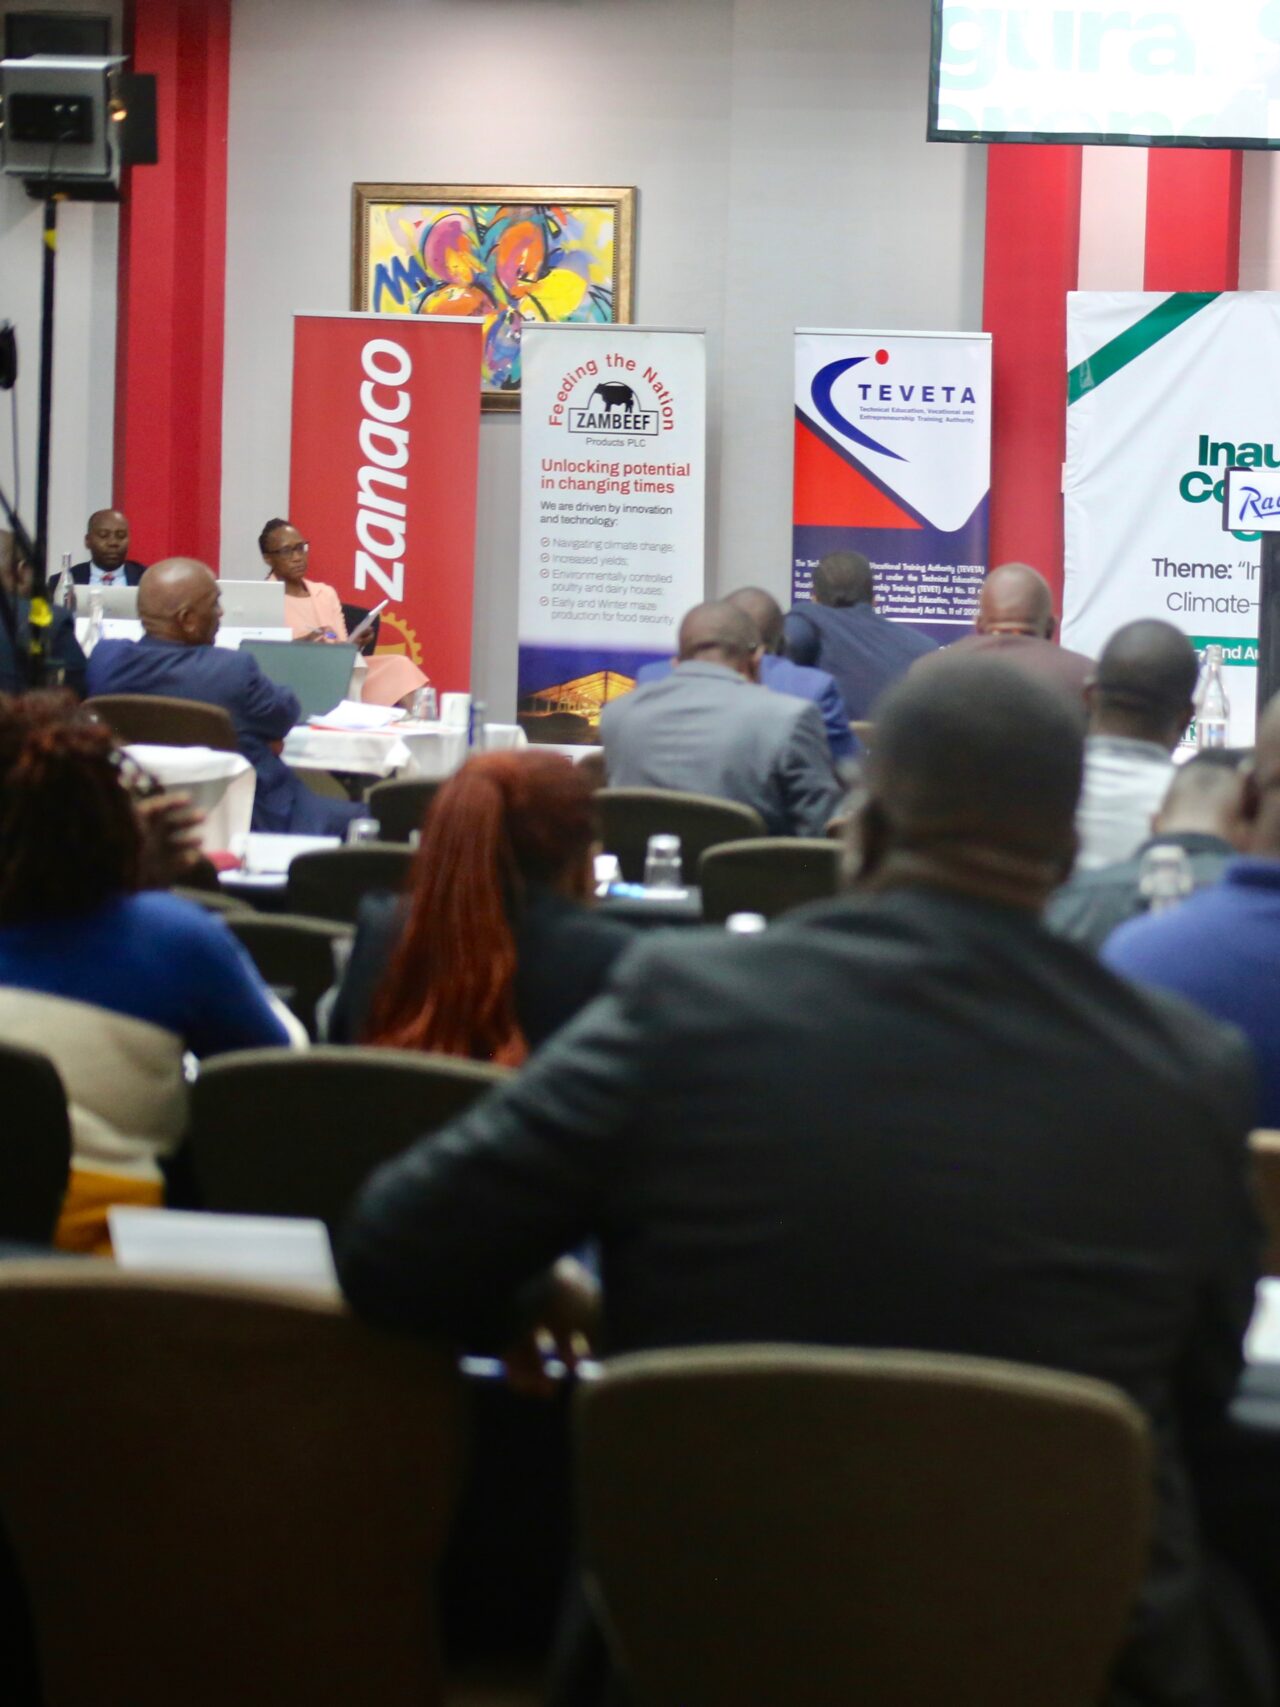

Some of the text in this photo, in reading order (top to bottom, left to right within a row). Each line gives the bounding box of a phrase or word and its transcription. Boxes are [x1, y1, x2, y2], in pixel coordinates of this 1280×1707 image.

[548, 353, 675, 430] Feeding the Nation
[858, 384, 976, 404] TEVETA
[576, 412, 651, 430] ZAMBEEF
[860, 414, 974, 424] Entrepreneurship Training Authority
[586, 437, 646, 448] Products PLC
[354, 338, 413, 601] zanaco
[541, 459, 691, 477] Unlocking potential
[541, 475, 675, 495] in changing times
[540, 501, 673, 515] We are driven by innovation
[540, 514, 559, 524] and
[553, 538, 603, 550] Navigating
[604, 539, 638, 550] climate
[553, 554, 598, 565] Increased
[1152, 558, 1233, 580] Theme:
[552, 569, 673, 584] Environmentally controlled
[552, 582, 582, 594] poultry
[585, 583, 603, 593] and
[605, 583, 628, 595] dairy
[552, 597, 657, 611] Early and Winter maize
[1166, 592, 1261, 614] Climate-
[552, 610, 600, 621] production
[602, 611, 614, 621] for
[616, 611, 637, 622] food
